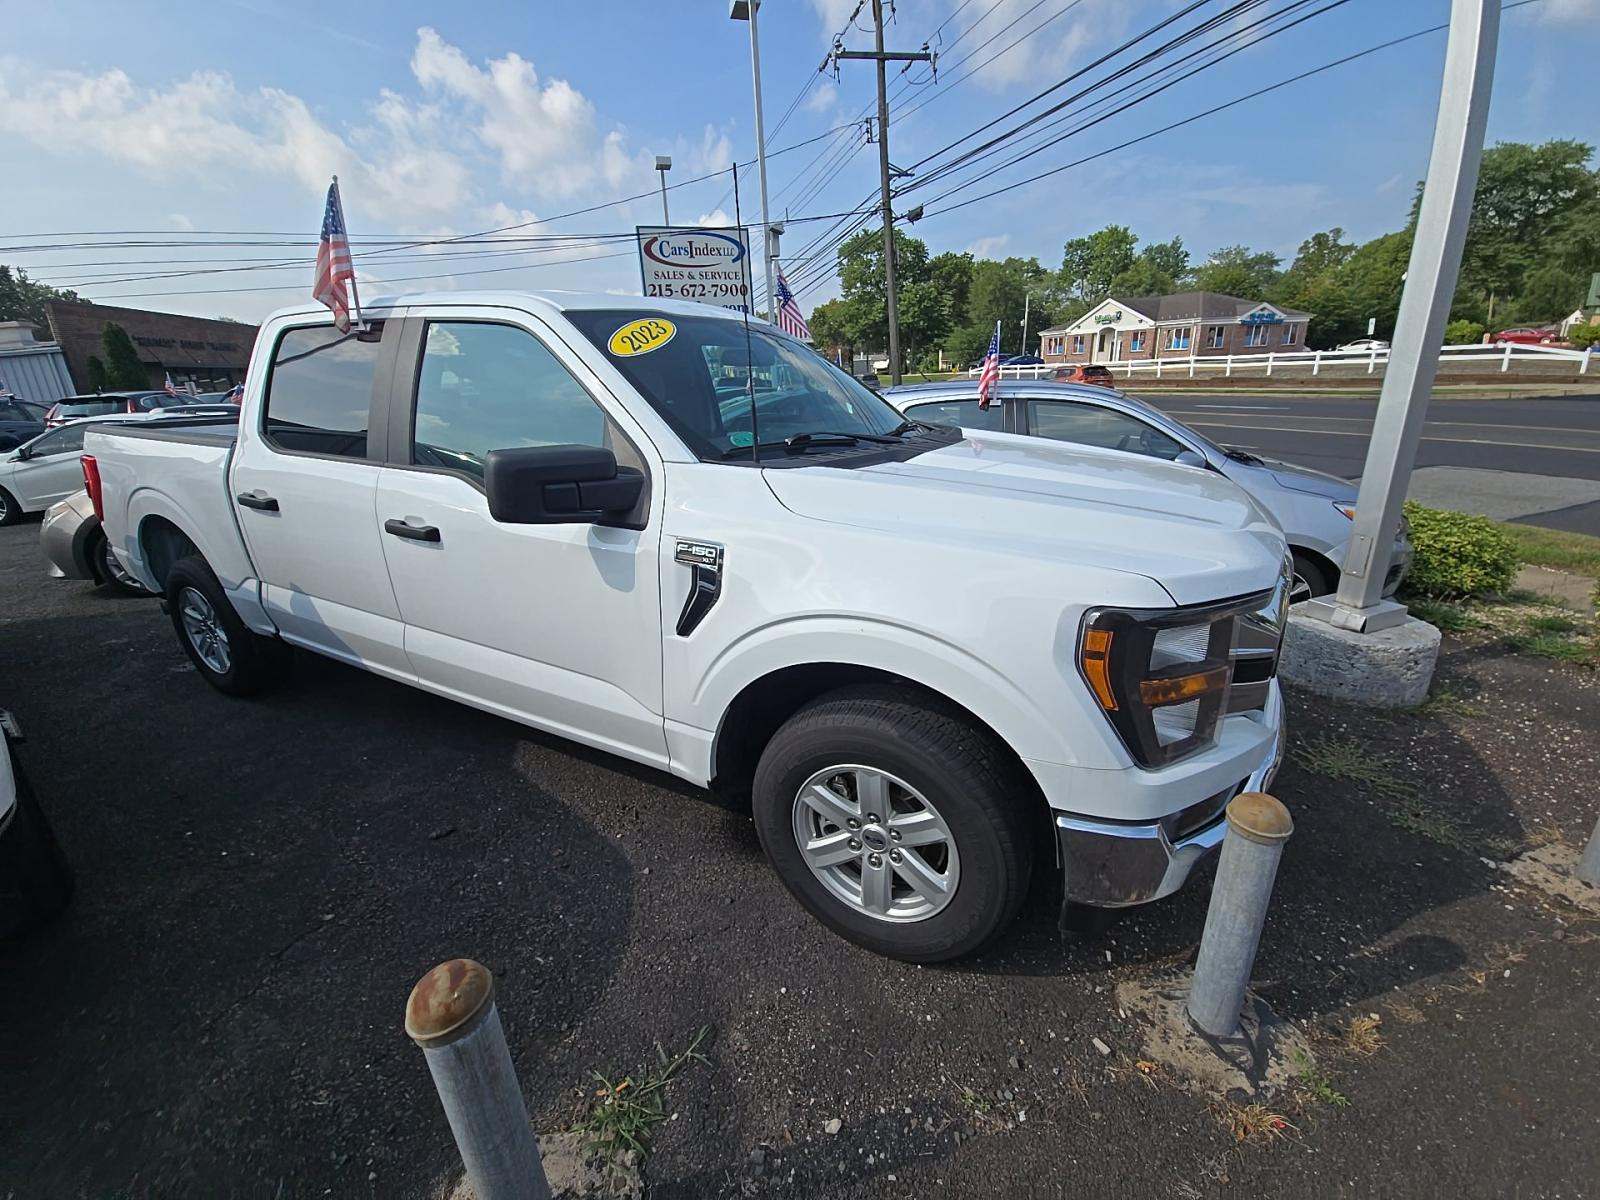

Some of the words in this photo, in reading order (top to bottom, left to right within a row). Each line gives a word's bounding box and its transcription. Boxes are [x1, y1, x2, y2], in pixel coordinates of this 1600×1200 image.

[659, 240, 722, 258] CarsIndex
[653, 270, 685, 280] SALES
[687, 271, 696, 280] &
[698, 271, 741, 281] SERVICE
[648, 284, 748, 297] 215-672-7900
[621, 321, 667, 352] 2023
[677, 544, 716, 557] F-150
